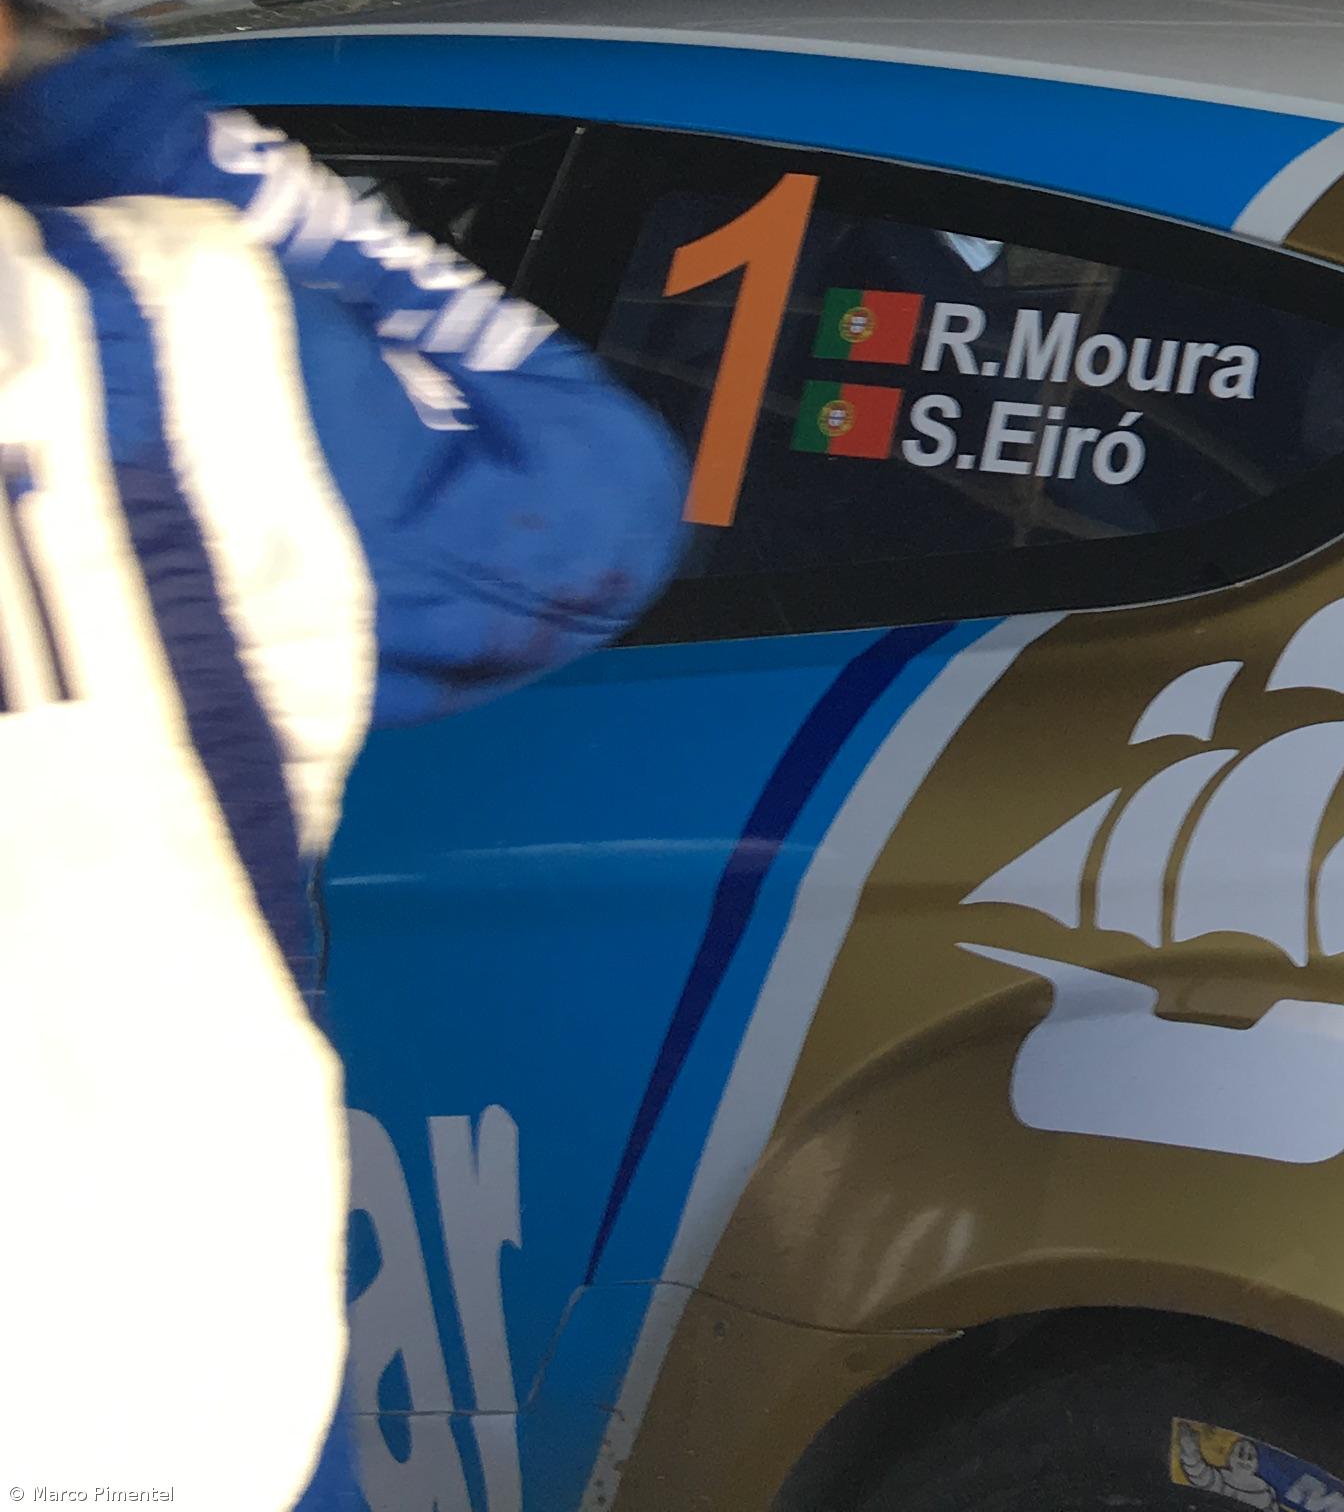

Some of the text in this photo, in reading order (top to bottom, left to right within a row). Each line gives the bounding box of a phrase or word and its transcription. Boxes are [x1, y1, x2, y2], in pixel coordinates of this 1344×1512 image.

[663, 173, 820, 527] 1
[901, 393, 1147, 486] S.Eiró
[921, 302, 1261, 400] R.Moura
[346, 1103, 522, 1512] ar
